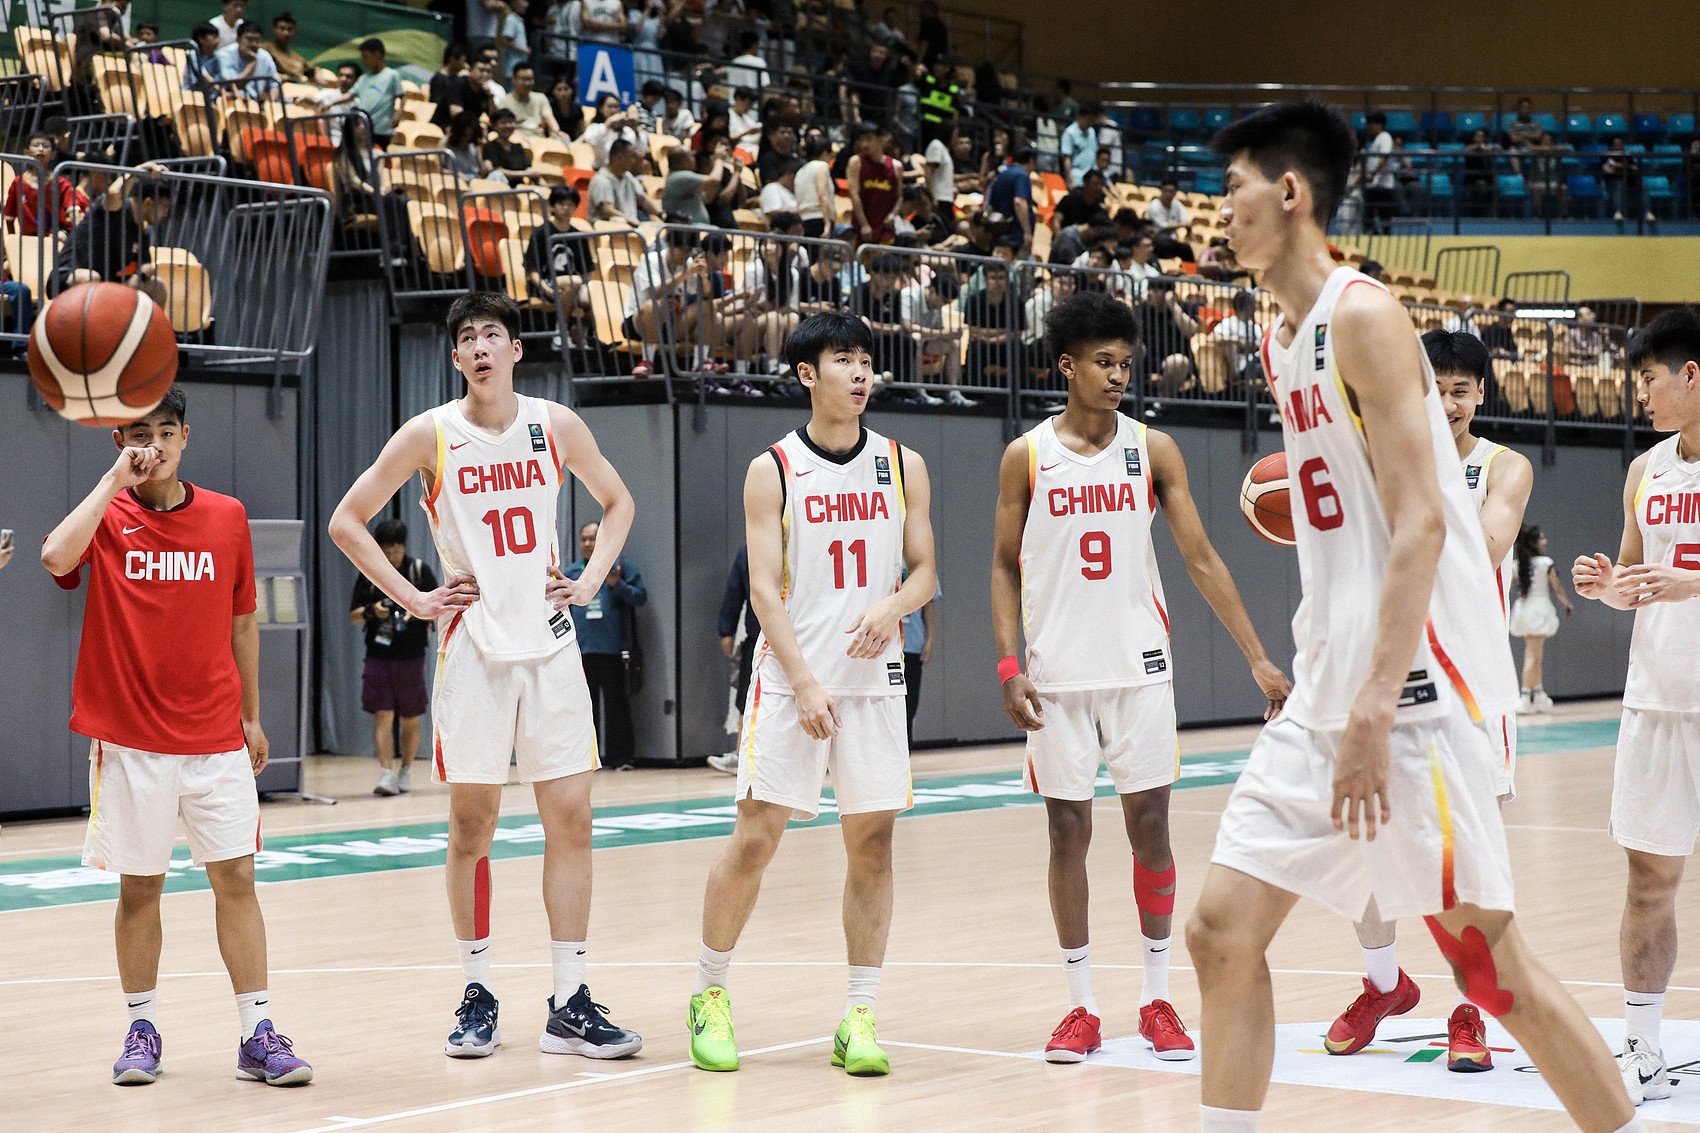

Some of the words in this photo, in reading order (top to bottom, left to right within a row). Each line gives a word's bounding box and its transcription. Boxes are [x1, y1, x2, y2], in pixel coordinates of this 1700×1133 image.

[585, 50, 621, 102] A
[458, 459, 546, 495] CHINA
[1048, 483, 1134, 516] CHINA
[1299, 456, 1344, 531] 6
[482, 506, 537, 557] 10
[805, 491, 889, 523] CHINA
[125, 550, 215, 581] CHINA
[828, 539, 867, 589] 11
[1079, 531, 1112, 581] 9
